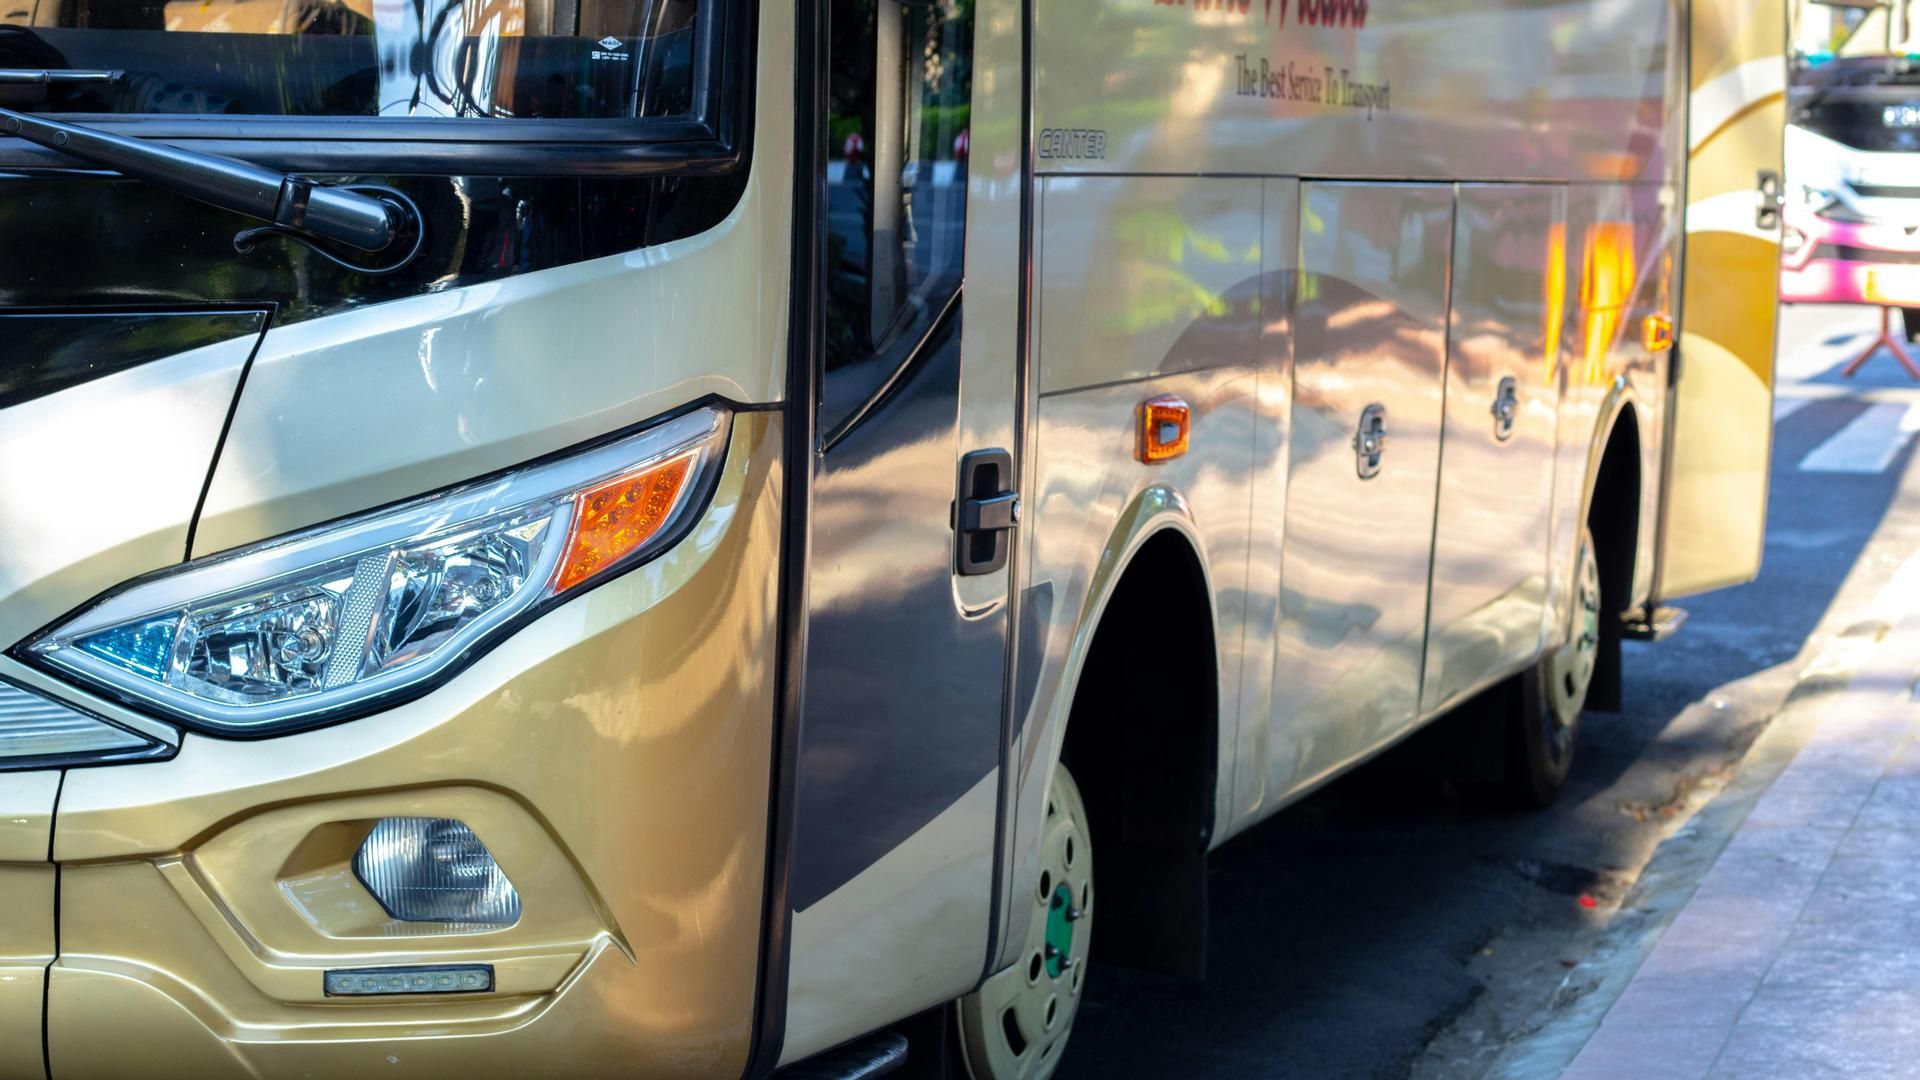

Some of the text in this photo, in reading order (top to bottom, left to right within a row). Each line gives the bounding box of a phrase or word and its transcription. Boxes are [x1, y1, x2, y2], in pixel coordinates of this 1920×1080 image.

[1235, 53, 1390, 121] The Best Service To Transport
[1039, 128, 1106, 159] CANTER
